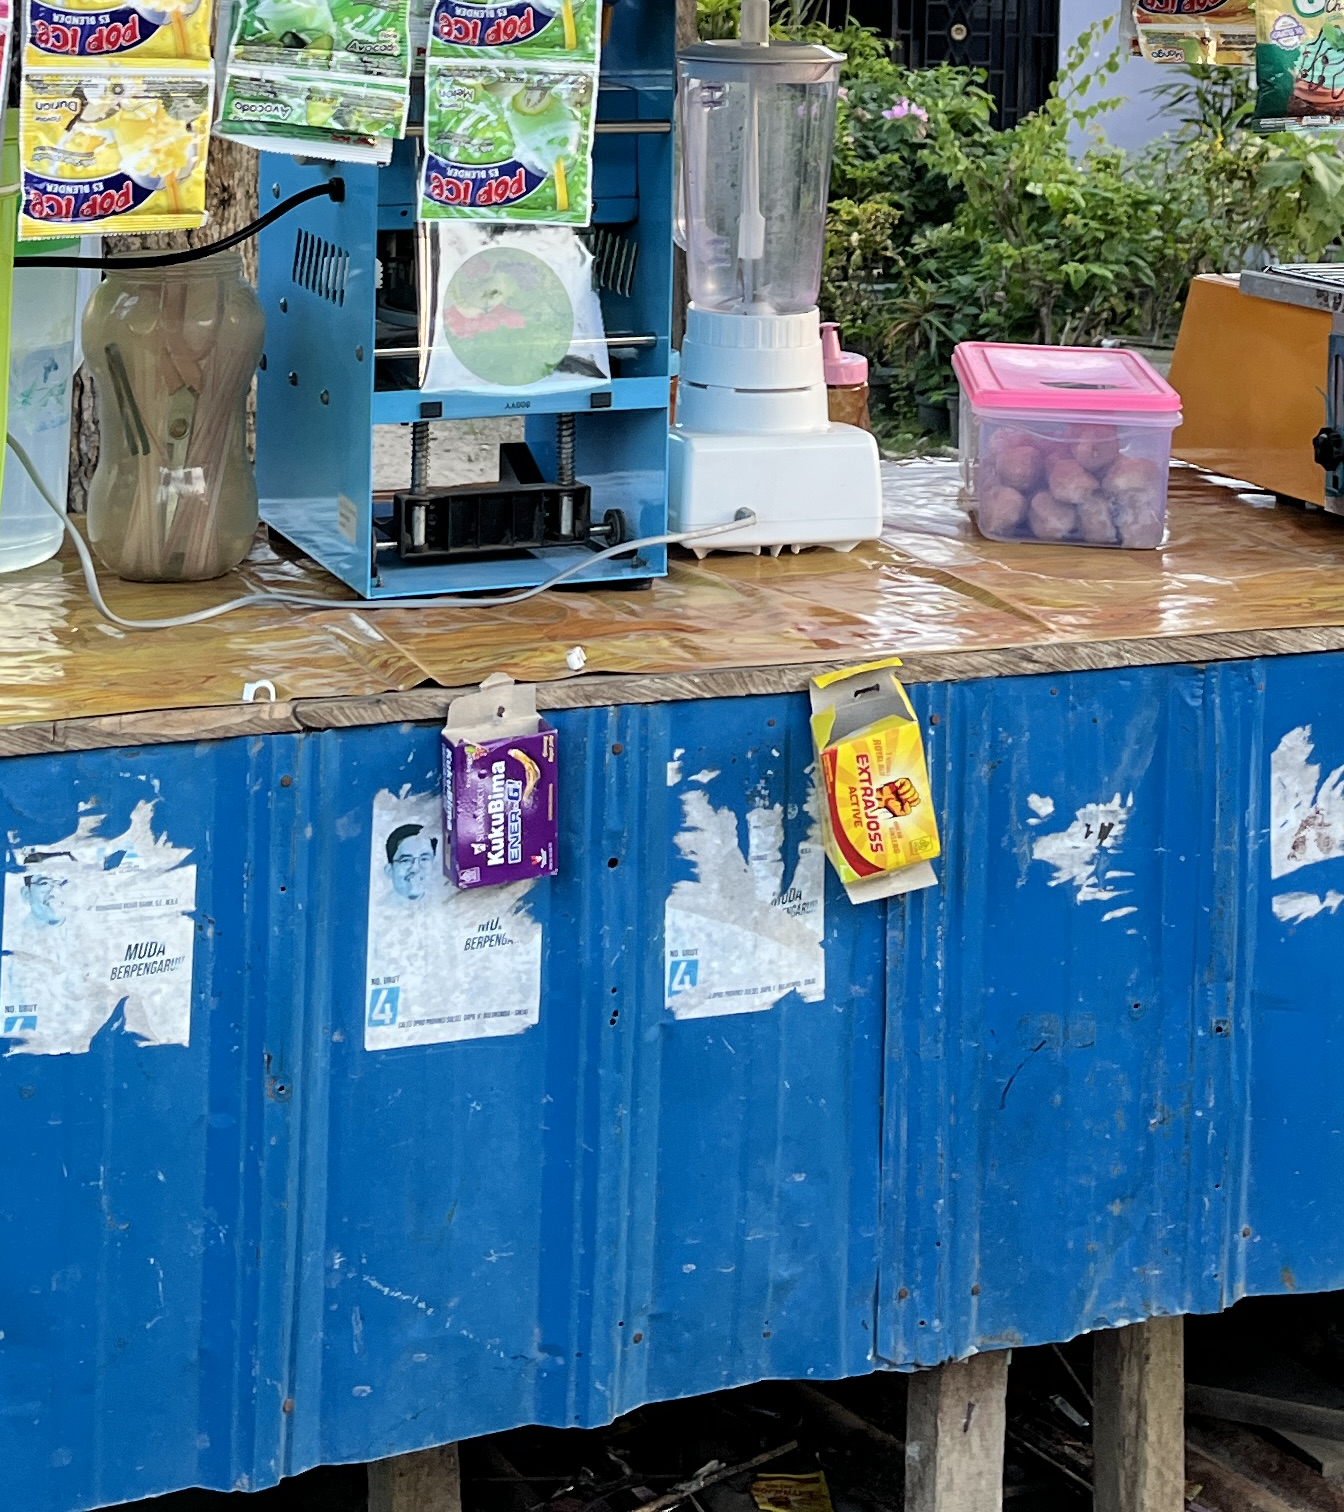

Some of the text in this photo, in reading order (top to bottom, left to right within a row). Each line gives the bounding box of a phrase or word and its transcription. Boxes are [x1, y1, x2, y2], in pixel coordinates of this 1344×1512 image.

[437, 86, 476, 100] Melon
[35, 101, 78, 114] Durian
[233, 101, 293, 119] Avocado
[486, 760, 506, 867] KukuBima
[848, 785, 864, 829] ACTIVE
[124, 941, 166, 961] MUDA
[670, 961, 693, 992] 4
[371, 989, 394, 1025] 4
